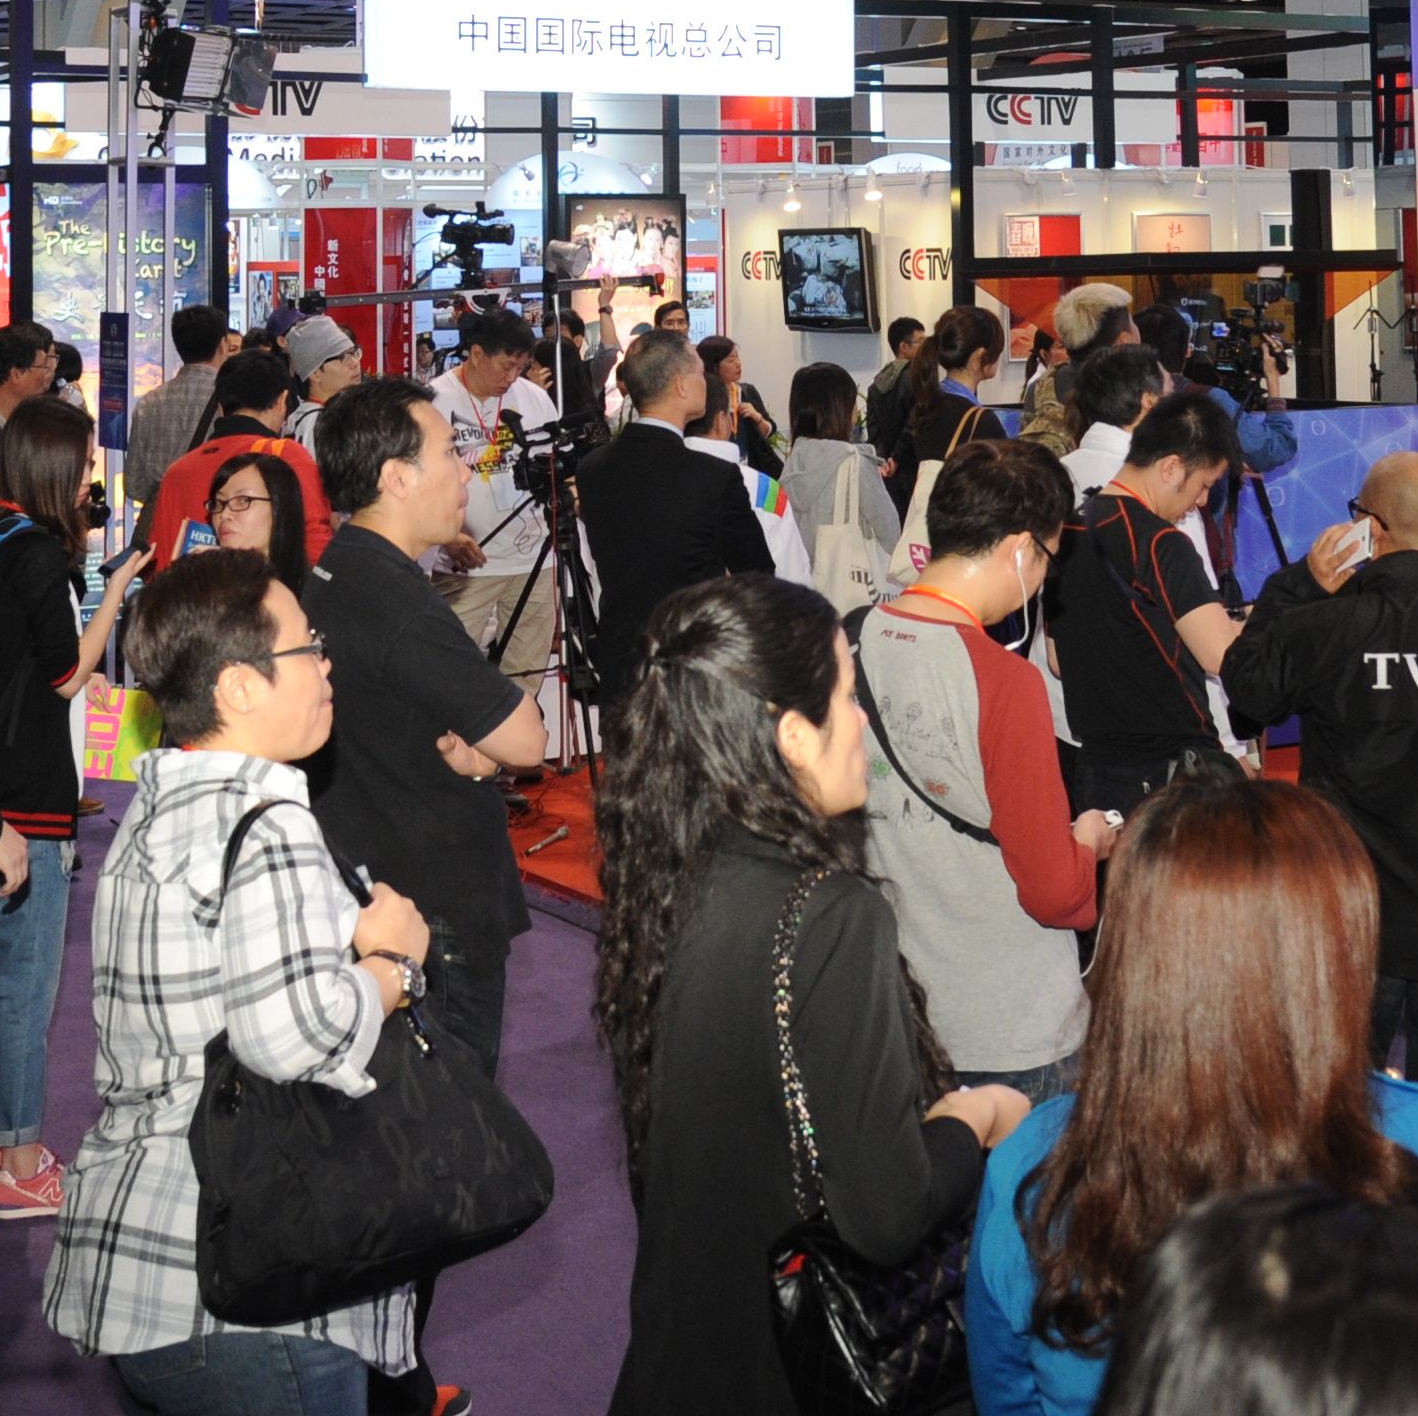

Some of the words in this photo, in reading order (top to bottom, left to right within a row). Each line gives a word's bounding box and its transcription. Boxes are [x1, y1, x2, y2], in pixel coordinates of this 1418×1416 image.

[457, 14, 782, 61] 中国国际电视总公司
[986, 94, 1079, 126] CCTV
[58, 218, 91, 235] The
